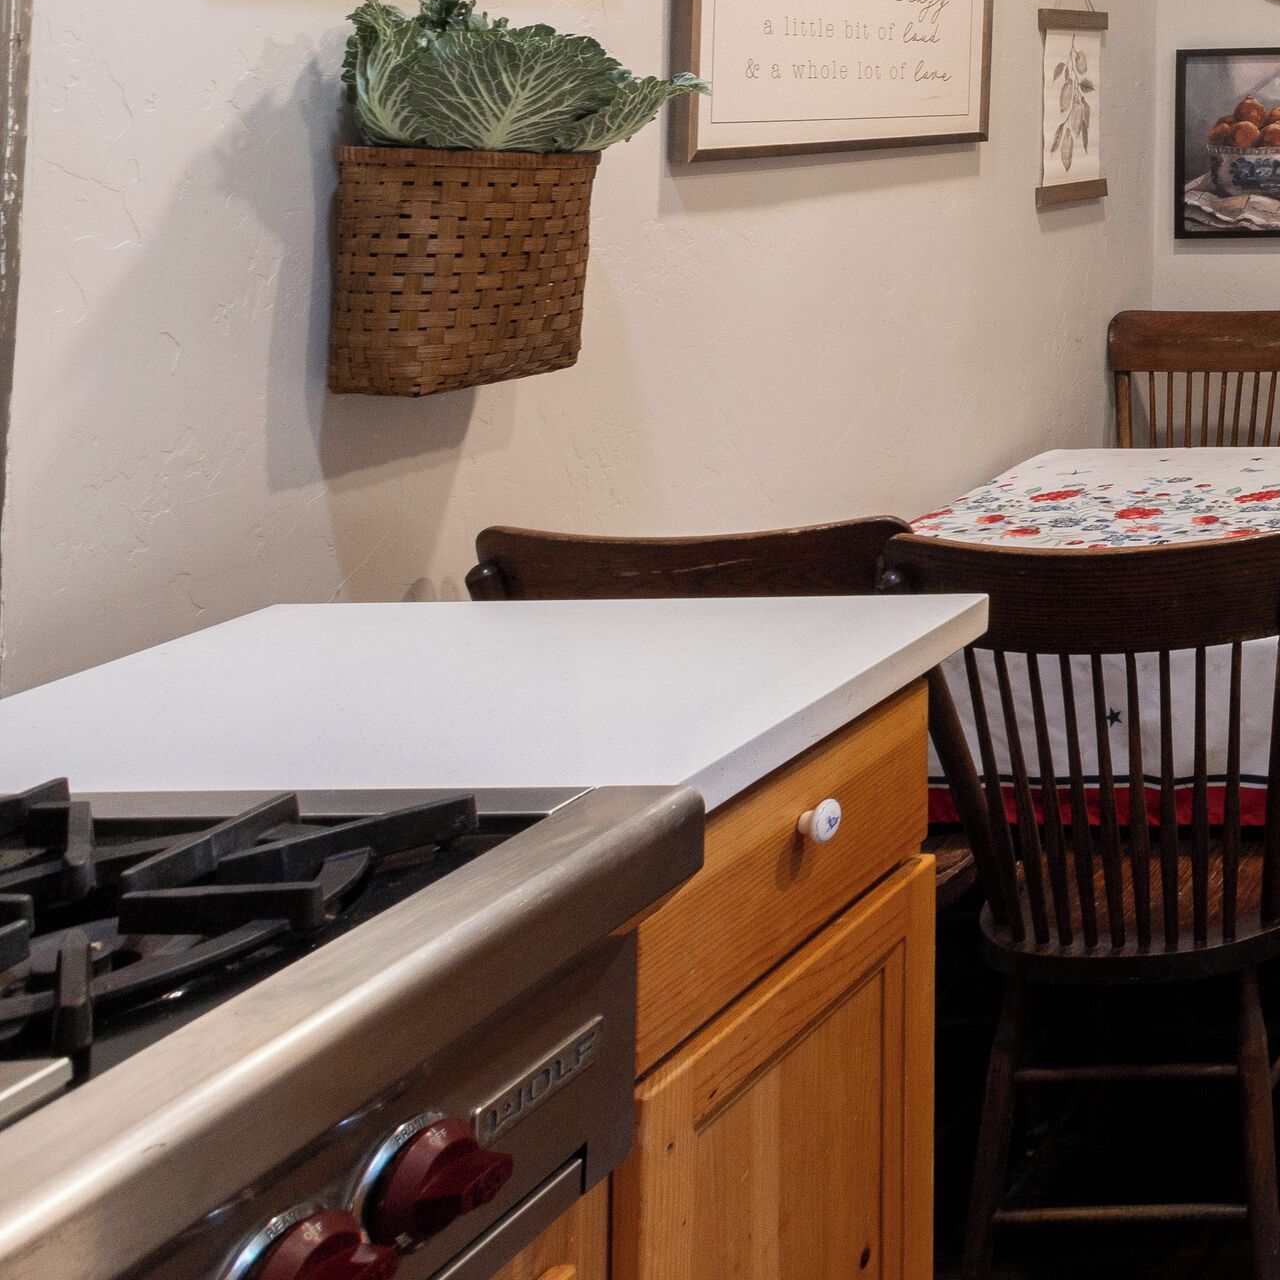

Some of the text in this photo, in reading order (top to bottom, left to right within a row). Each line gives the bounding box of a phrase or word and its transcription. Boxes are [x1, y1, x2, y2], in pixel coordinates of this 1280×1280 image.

[763, 16, 941, 45] a little bit of loud
[745, 58, 952, 83] & a whole lot of love
[488, 1031, 596, 1131] WOLF
